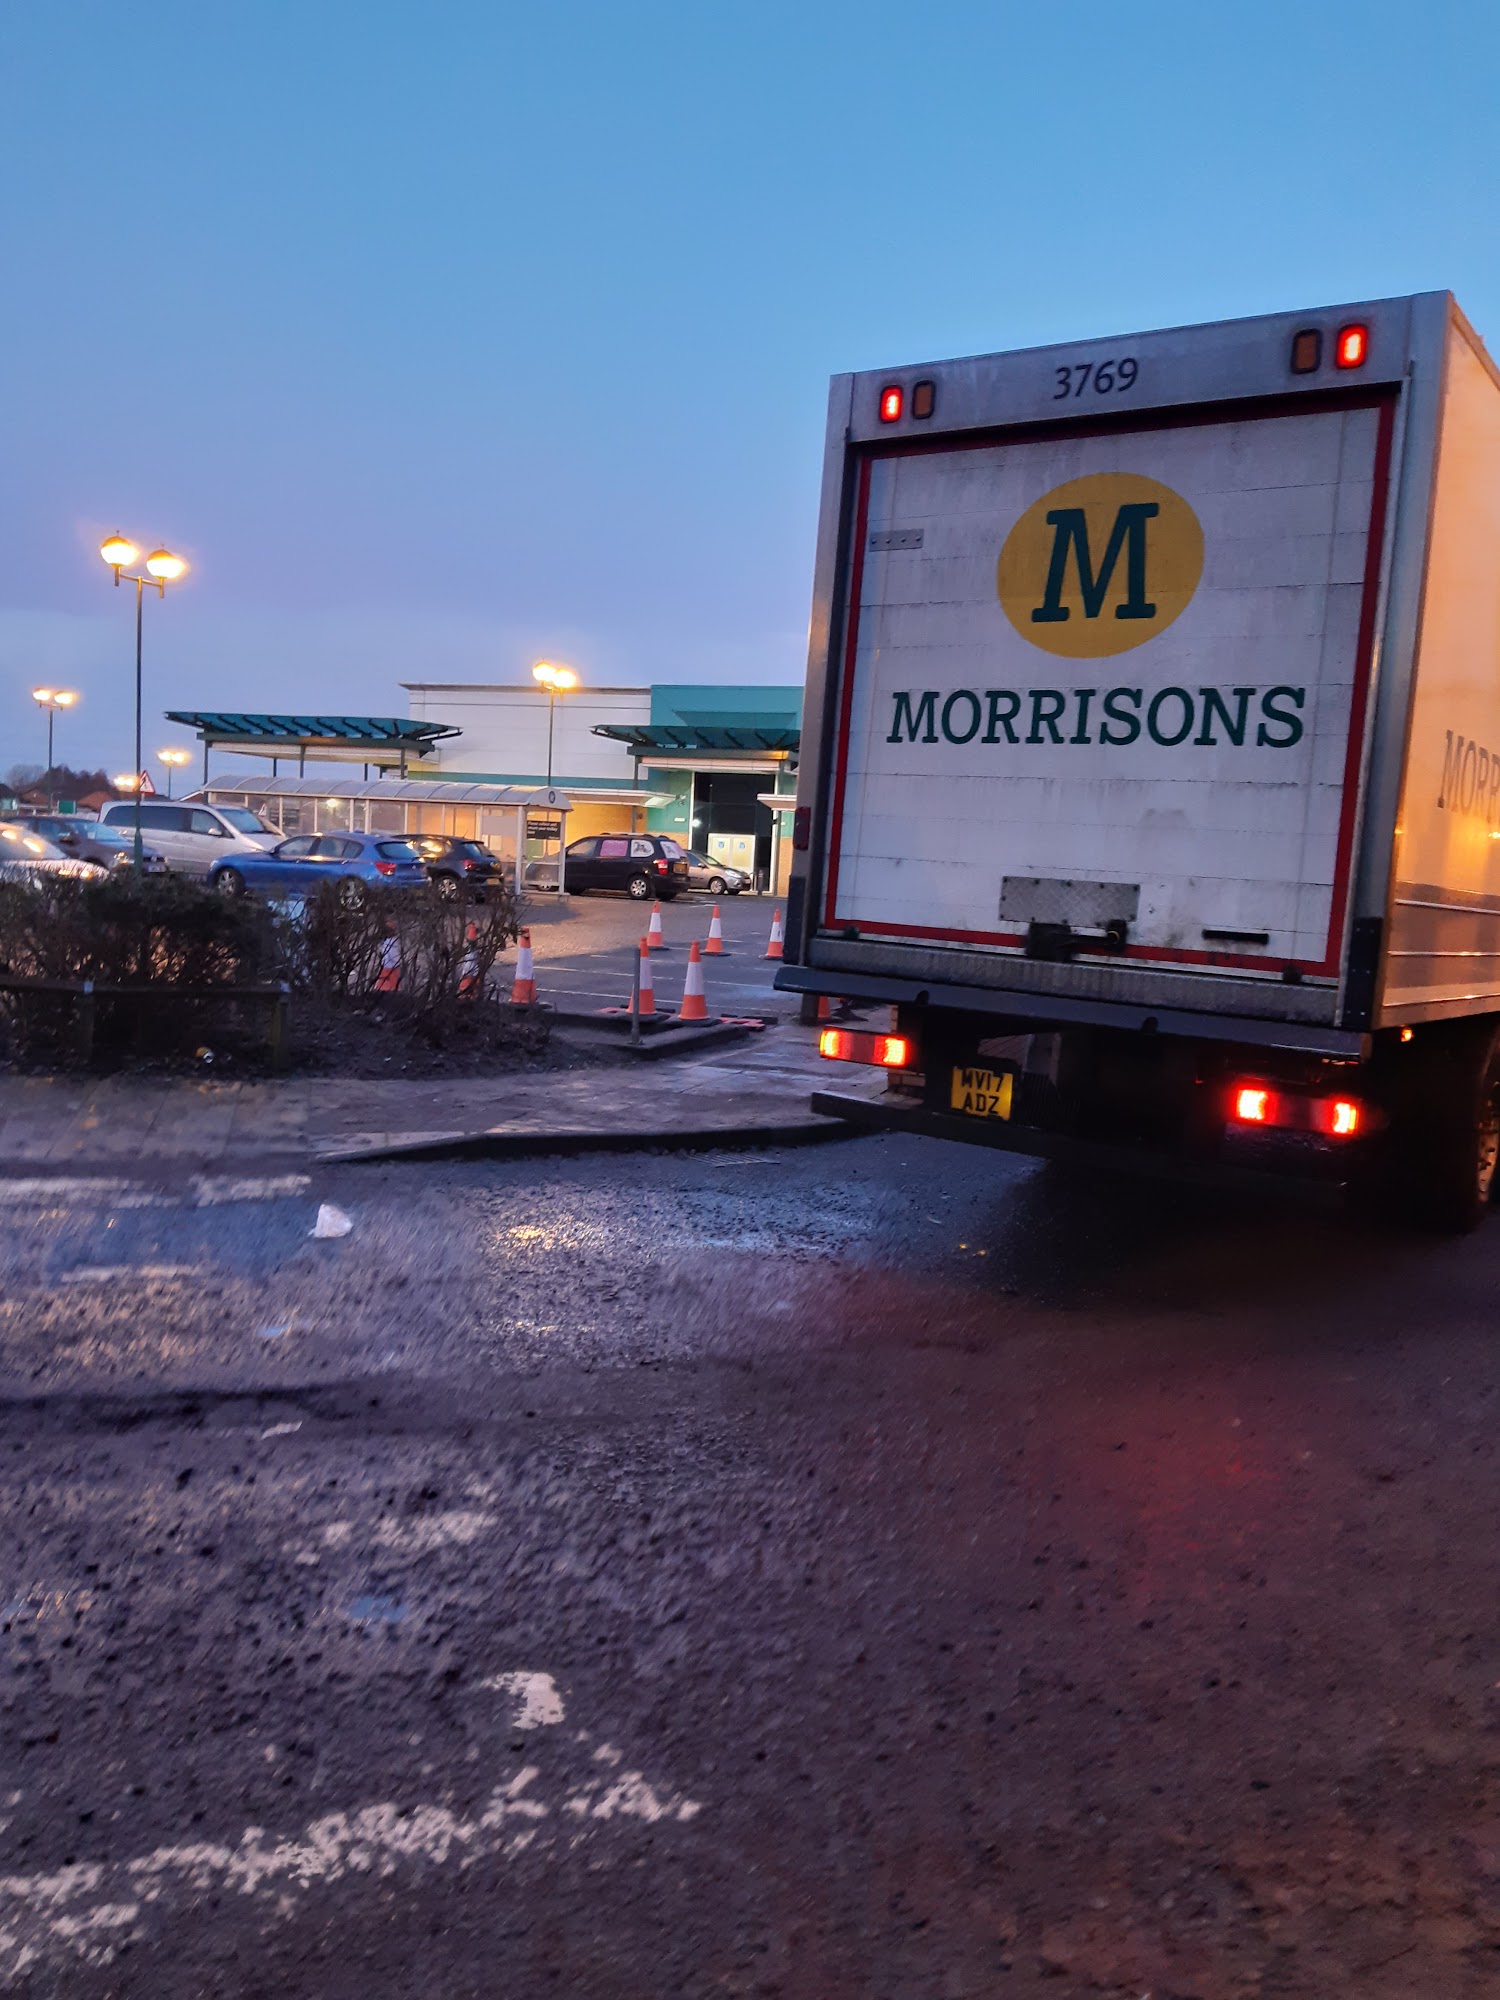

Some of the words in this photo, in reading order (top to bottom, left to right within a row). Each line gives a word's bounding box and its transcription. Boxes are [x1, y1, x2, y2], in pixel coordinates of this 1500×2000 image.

[1053, 358, 1138, 400] 3769
[1031, 502, 1159, 622] M
[886, 686, 1306, 748] MORRISONS
[963, 1092, 1000, 1115] ADZ
